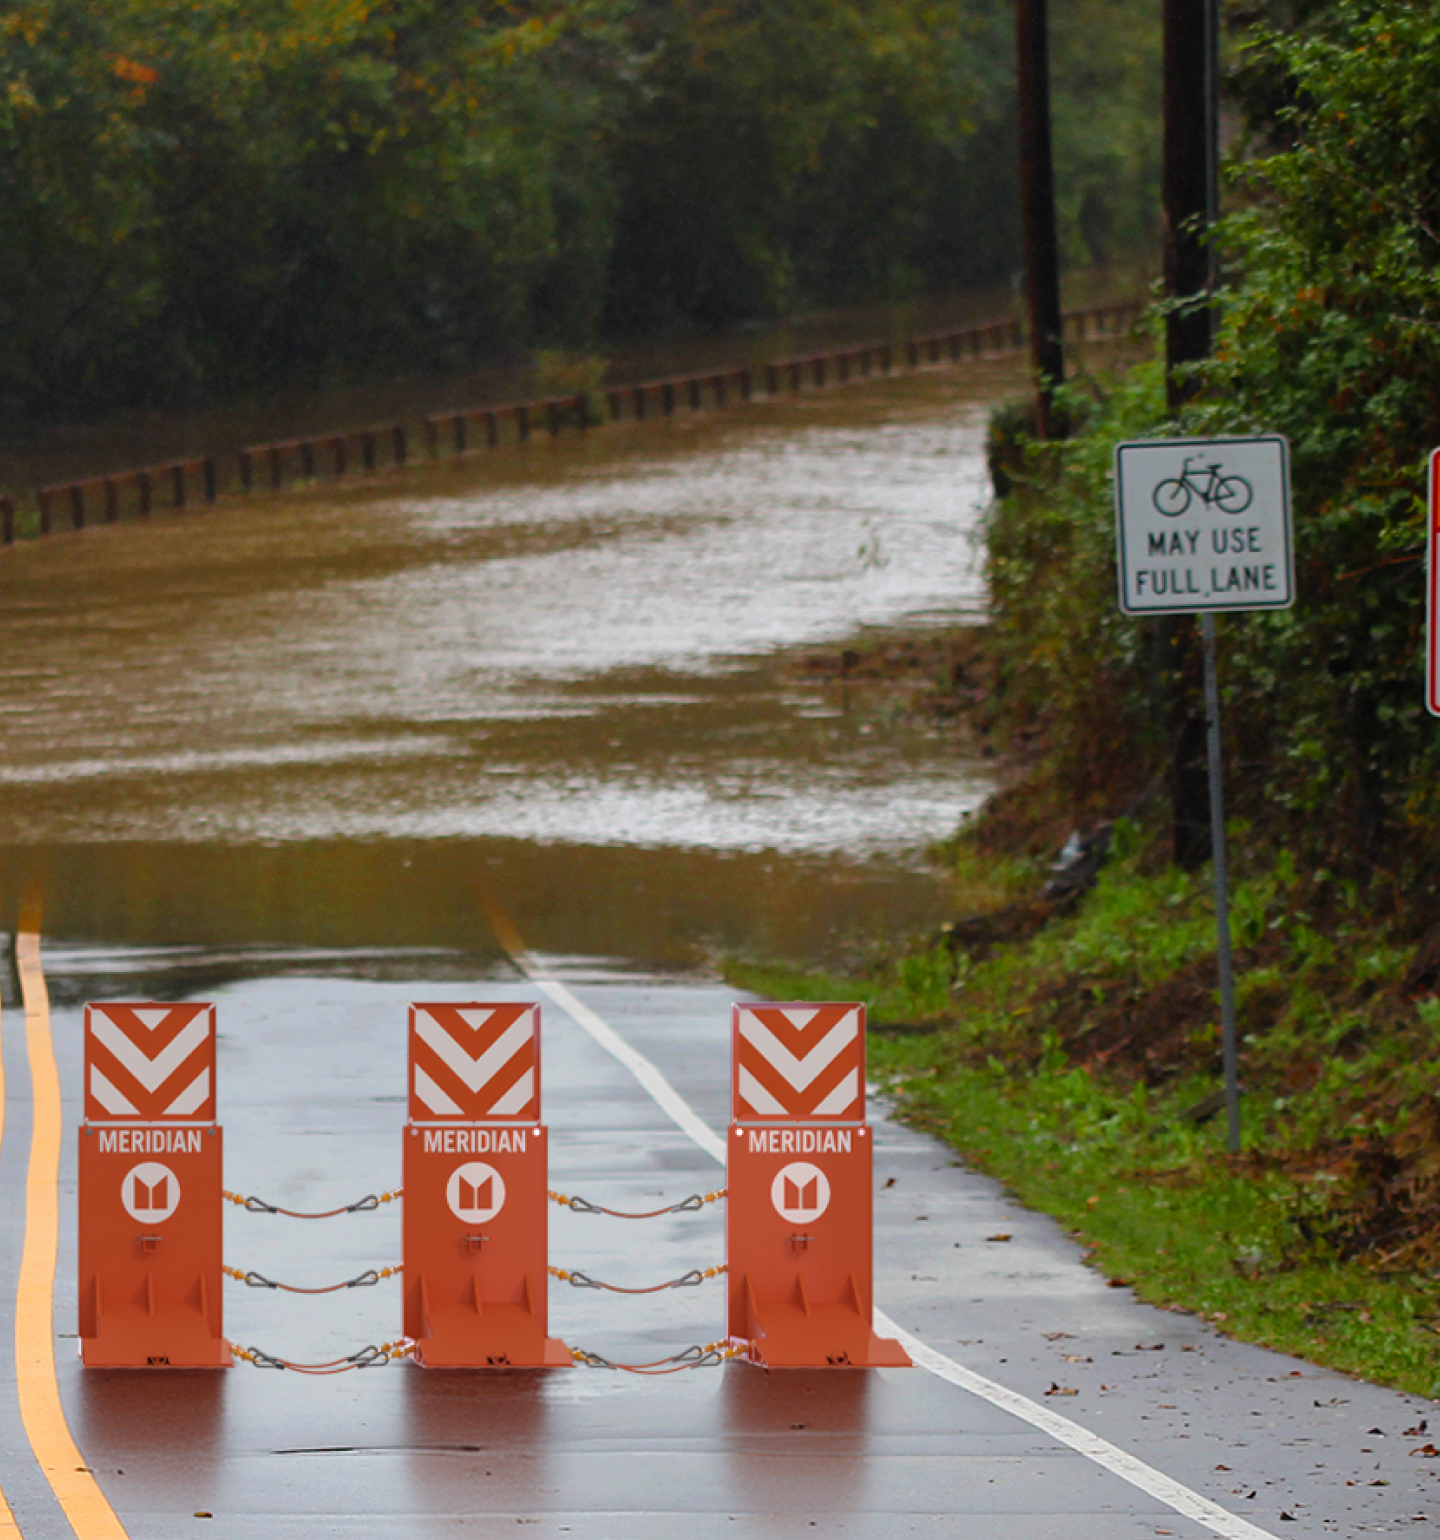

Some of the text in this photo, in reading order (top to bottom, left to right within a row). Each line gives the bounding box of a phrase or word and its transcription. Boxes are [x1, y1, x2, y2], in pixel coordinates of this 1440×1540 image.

[1147, 527, 1262, 557] MAY USE
[1136, 565, 1277, 595] FULL LANE
[99, 1129, 202, 1153] MERIDIAN
[424, 1129, 526, 1153] MERIDIAN
[748, 1129, 852, 1153] MERIDIAN
